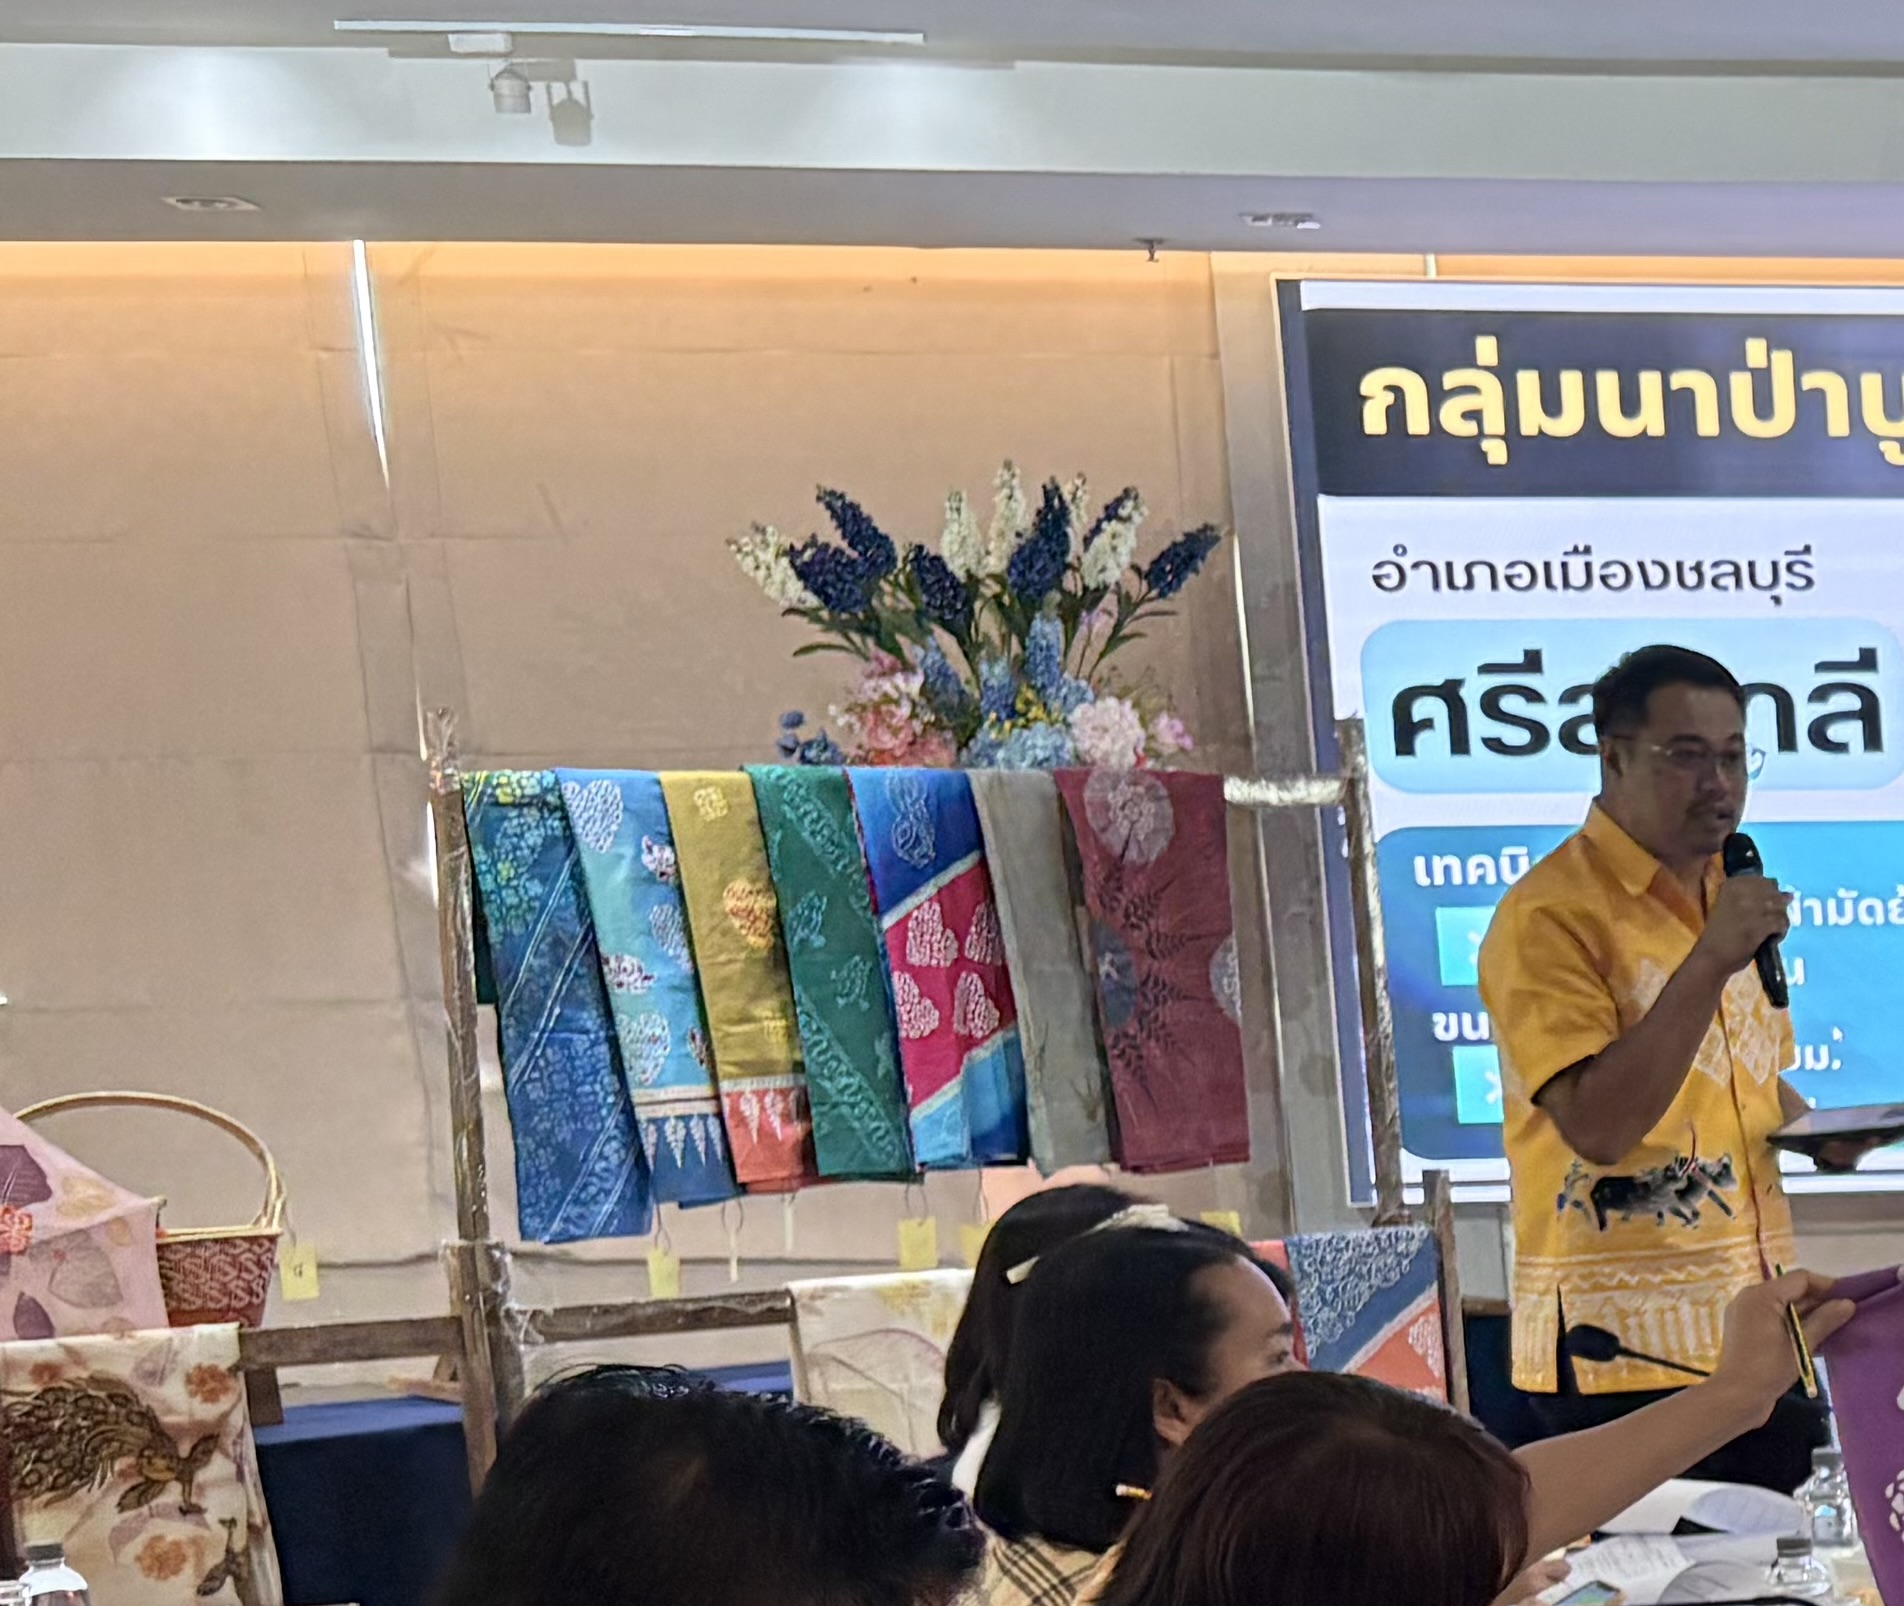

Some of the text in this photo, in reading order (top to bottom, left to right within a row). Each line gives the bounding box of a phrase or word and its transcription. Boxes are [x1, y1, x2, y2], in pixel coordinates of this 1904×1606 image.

[1370, 542, 1817, 606] อำเภอเมืองชลบุรี
